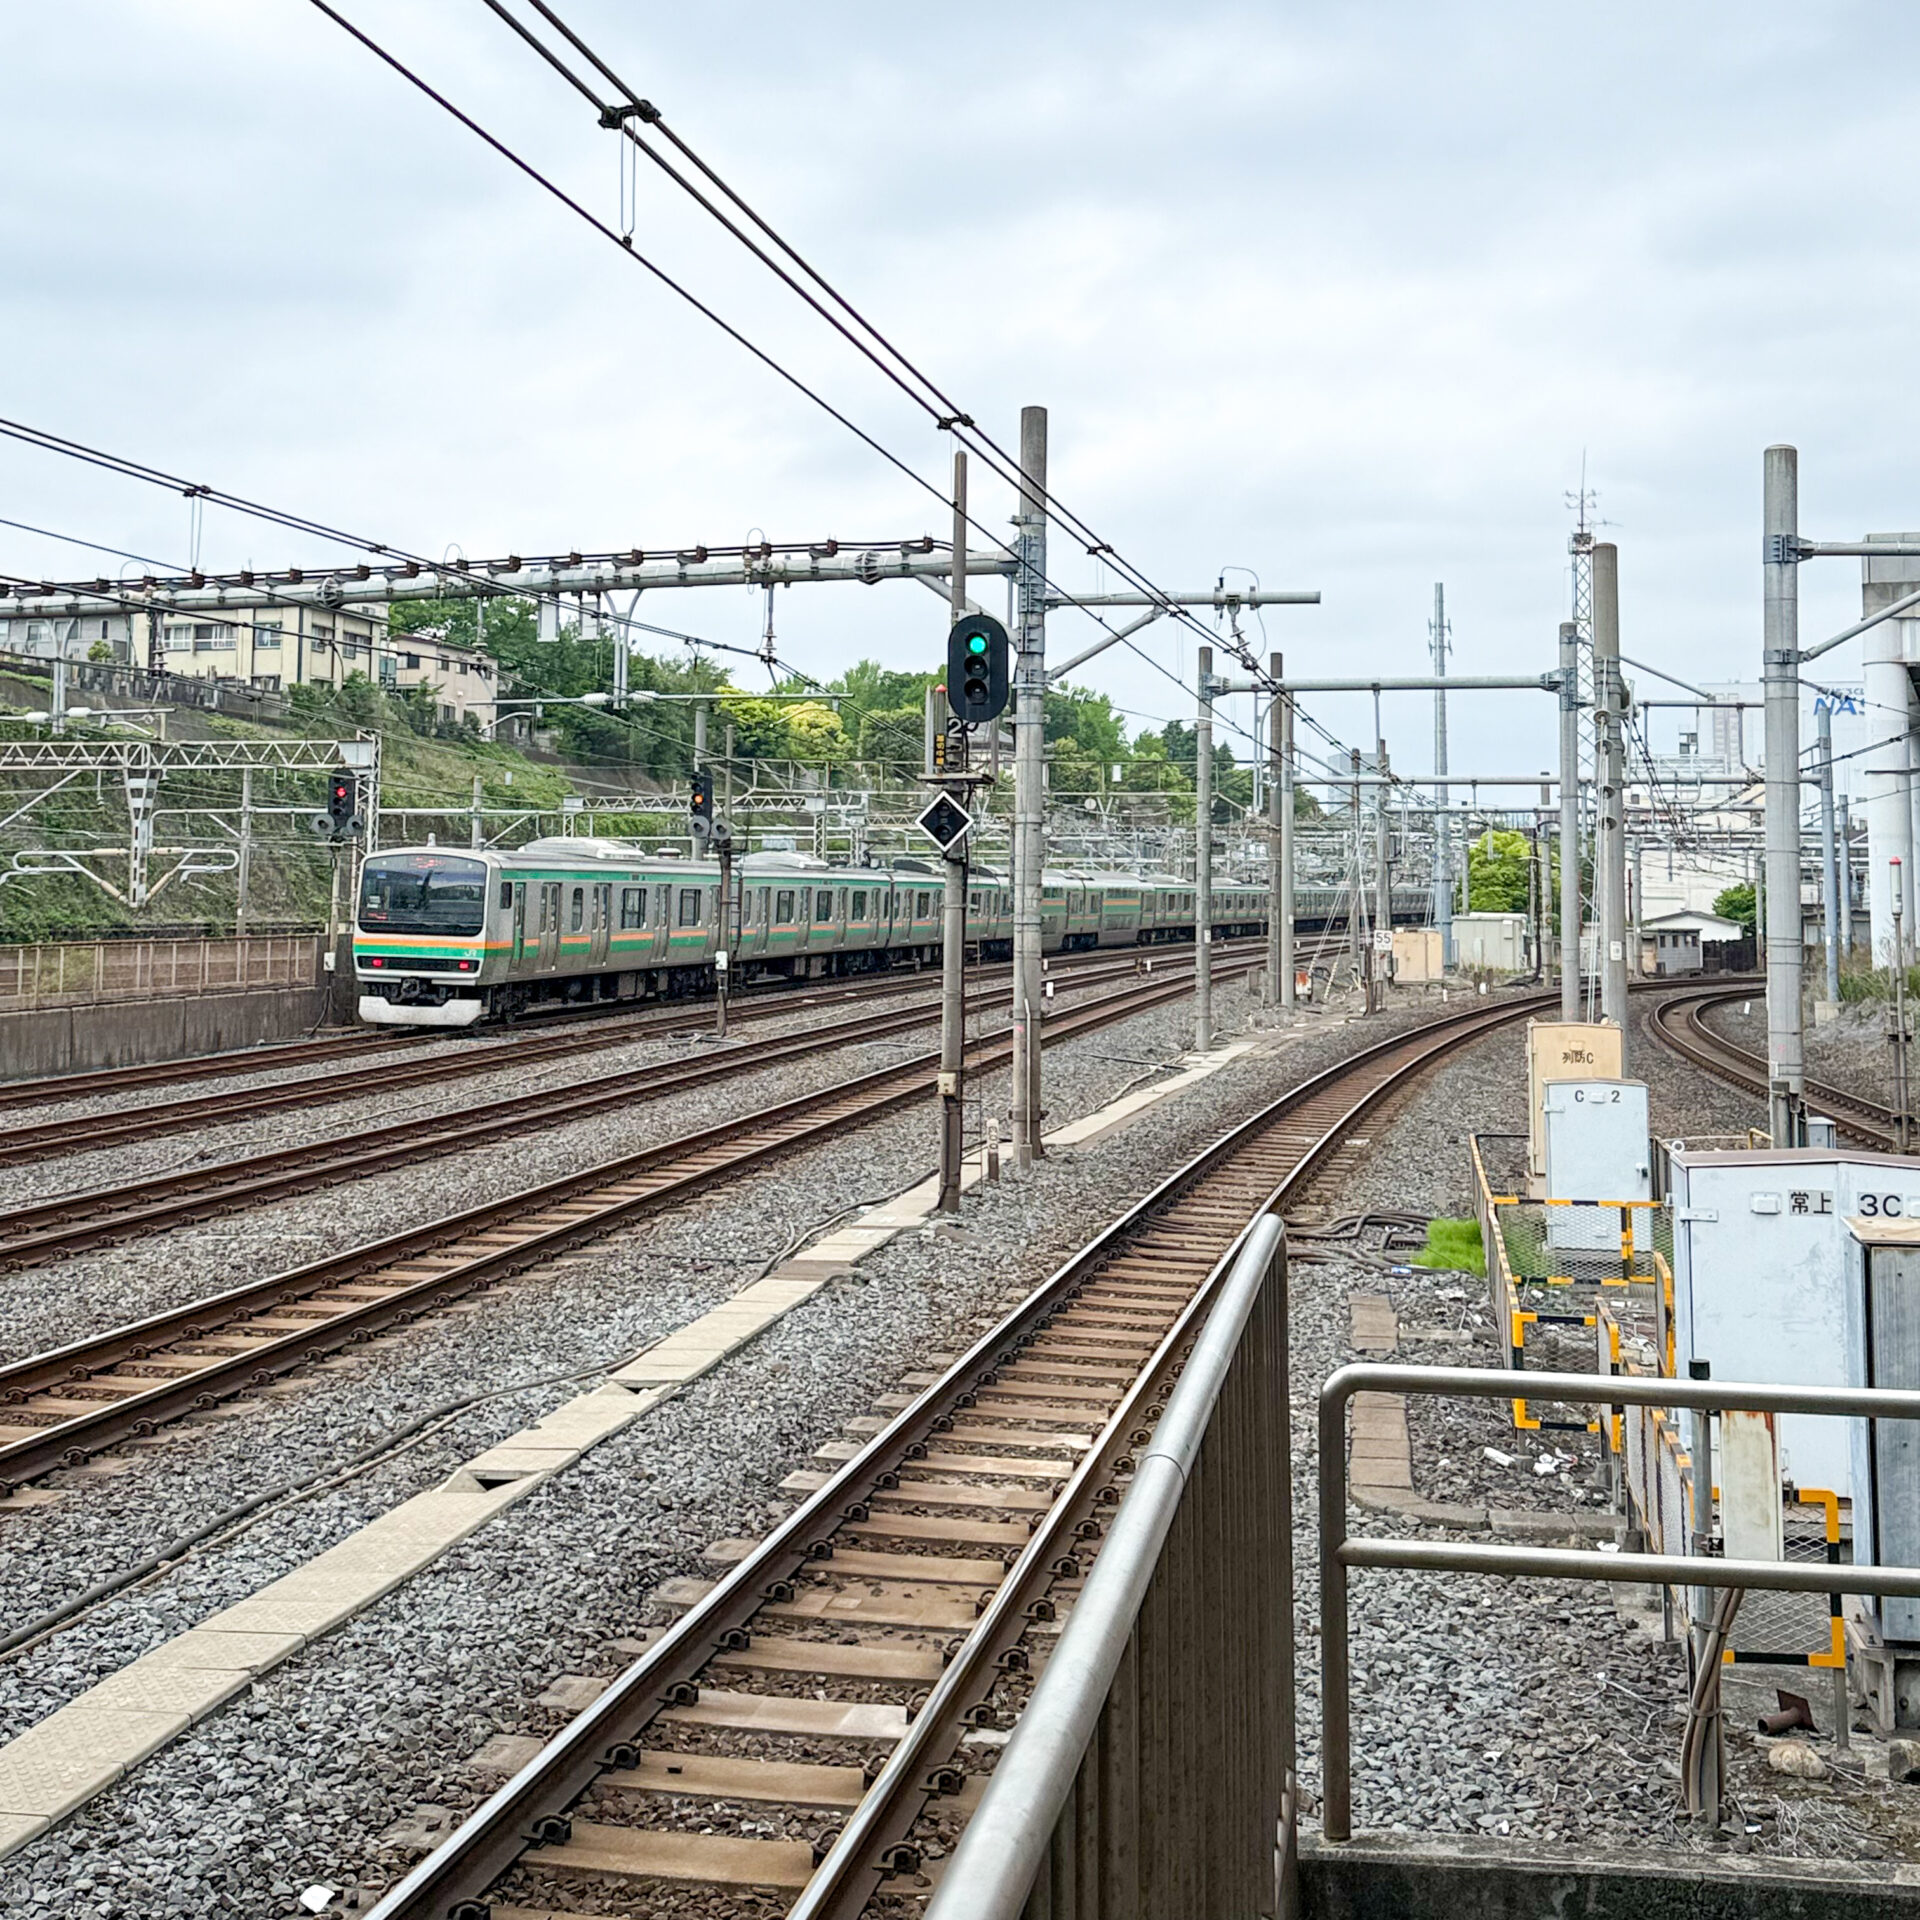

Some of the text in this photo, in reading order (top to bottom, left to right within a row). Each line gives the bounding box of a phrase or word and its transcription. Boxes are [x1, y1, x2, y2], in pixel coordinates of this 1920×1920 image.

[948, 718, 963, 738] 2
[1375, 932, 1391, 944] 55
[463, 949, 478, 957] JR
[1574, 1089, 1621, 1103] C 2
[1790, 1191, 1901, 1217] 常上 3C
